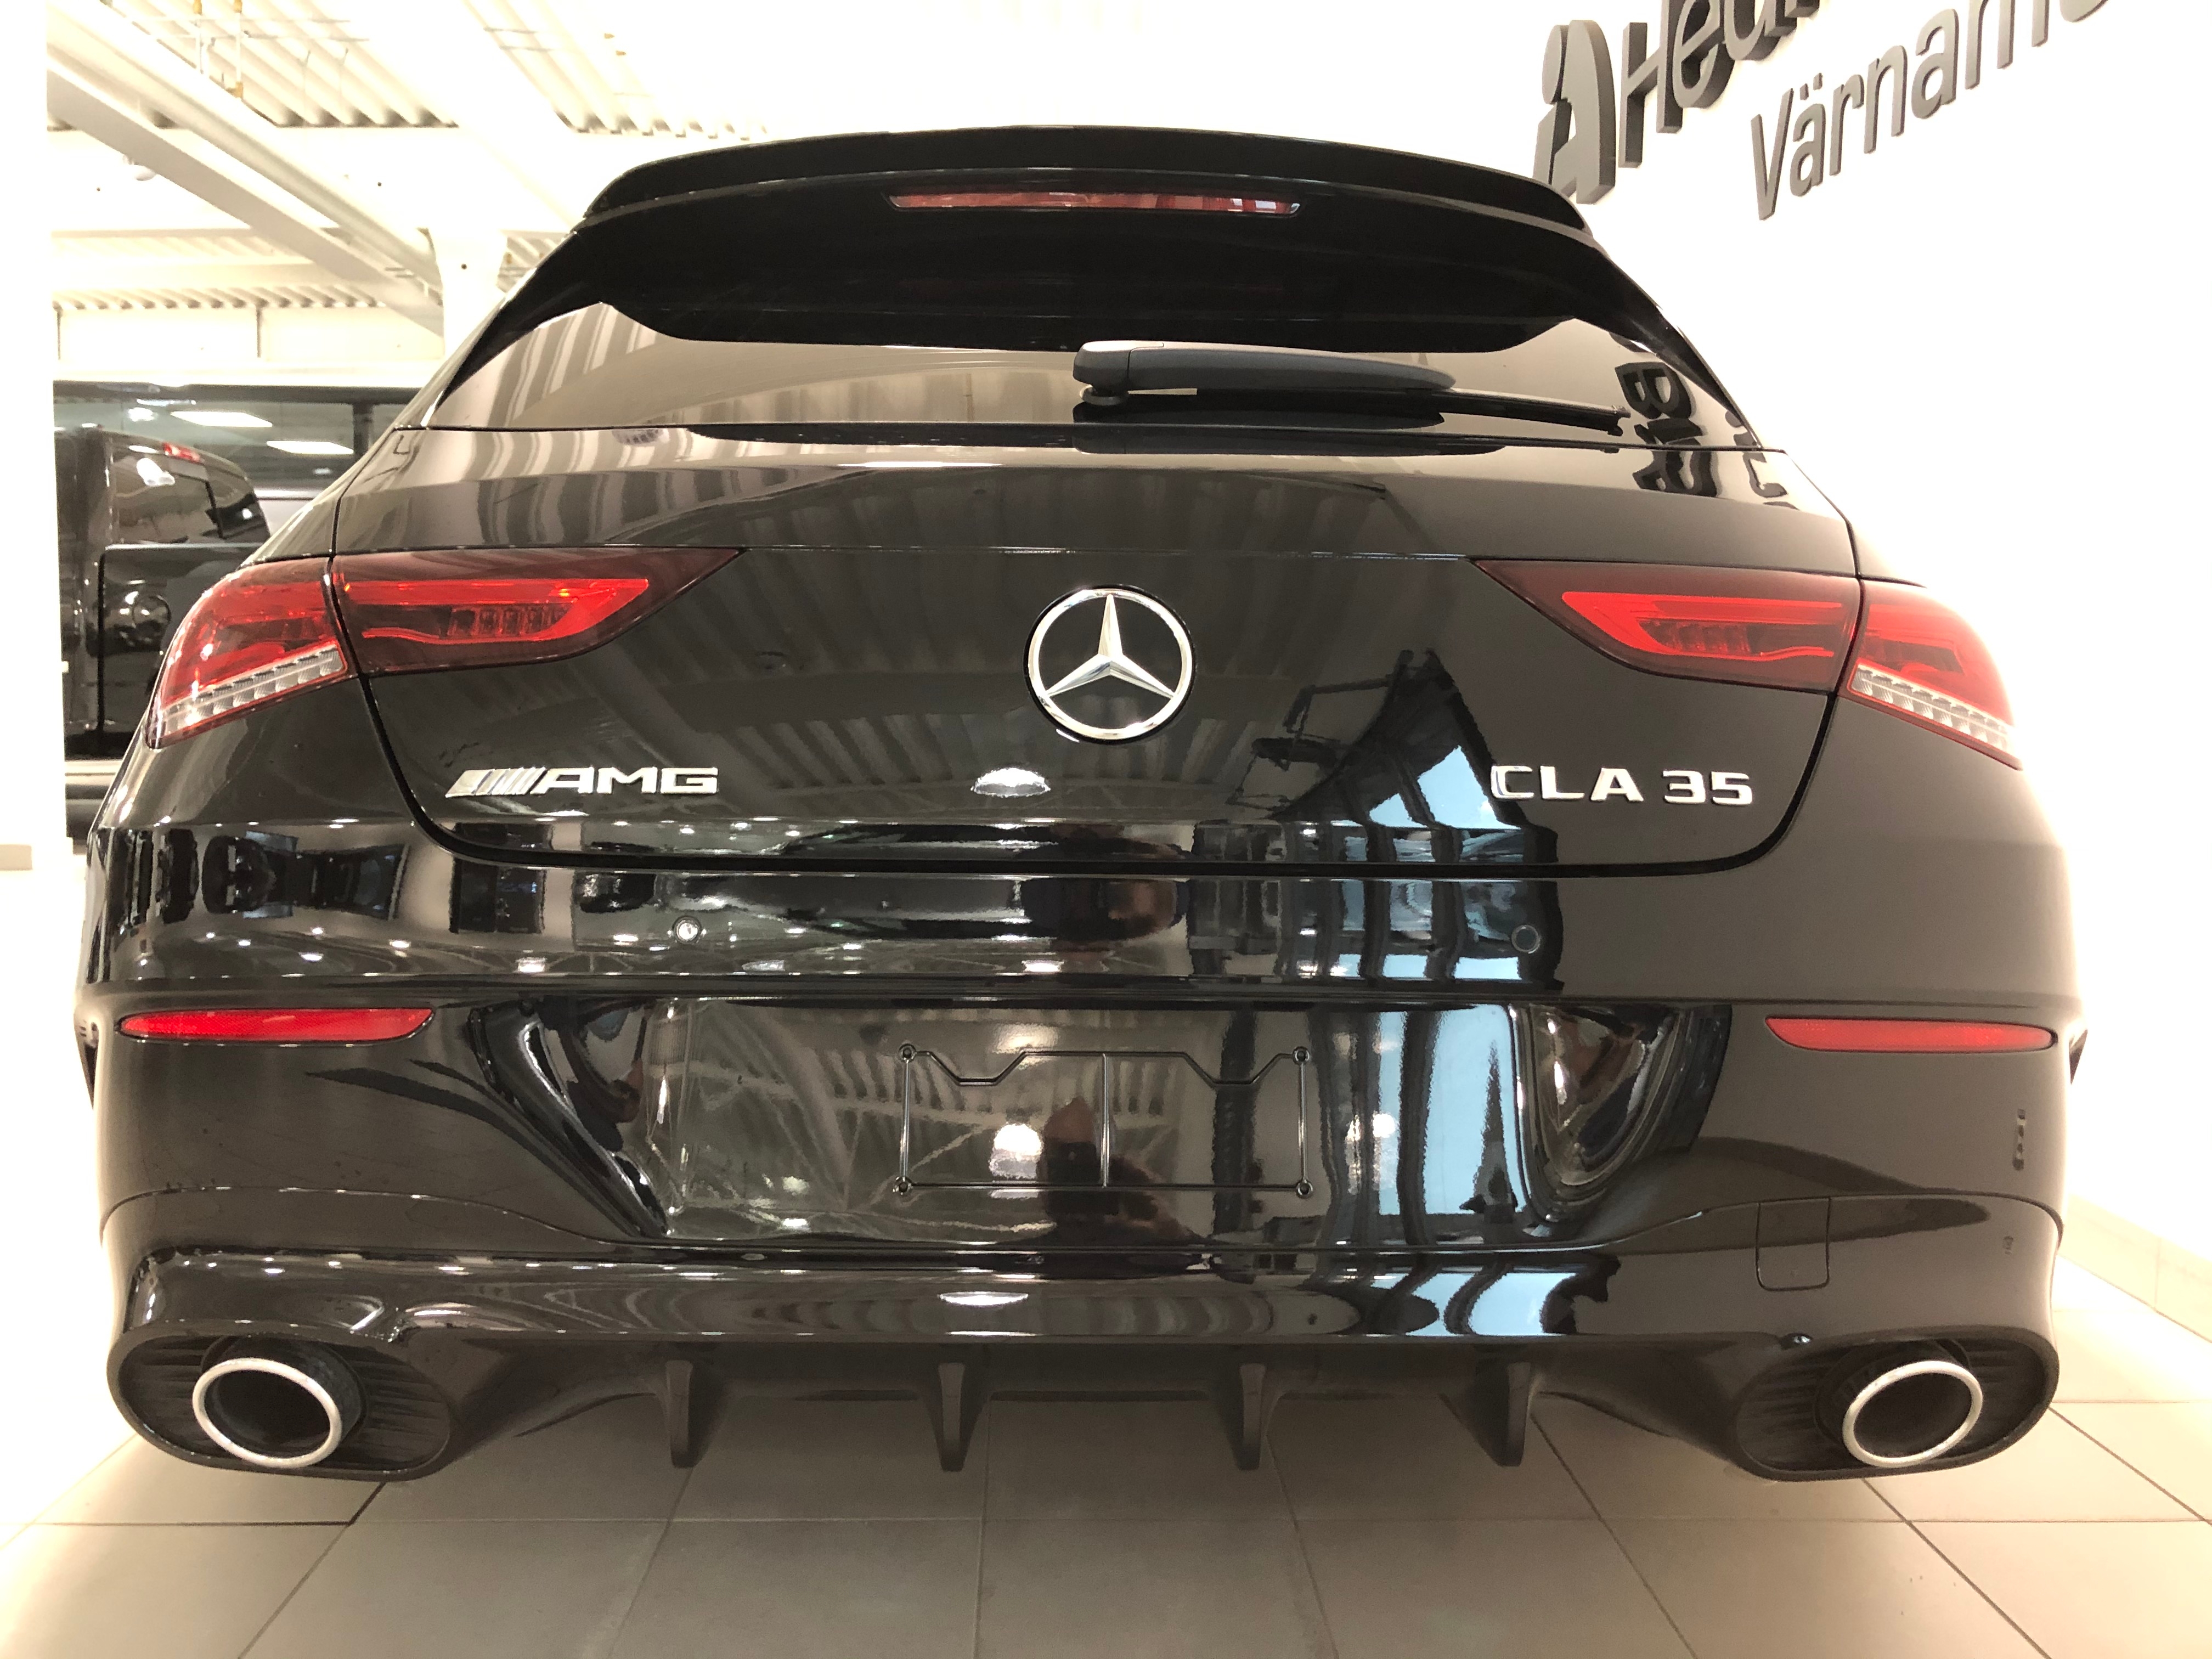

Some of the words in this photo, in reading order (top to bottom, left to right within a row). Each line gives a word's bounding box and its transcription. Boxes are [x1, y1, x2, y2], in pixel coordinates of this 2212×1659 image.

[1751, 0, 2108, 221] Värnam
[530, 766, 718, 794] AMG
[1491, 765, 1644, 802] CLA
[1662, 769, 1753, 805] 35
